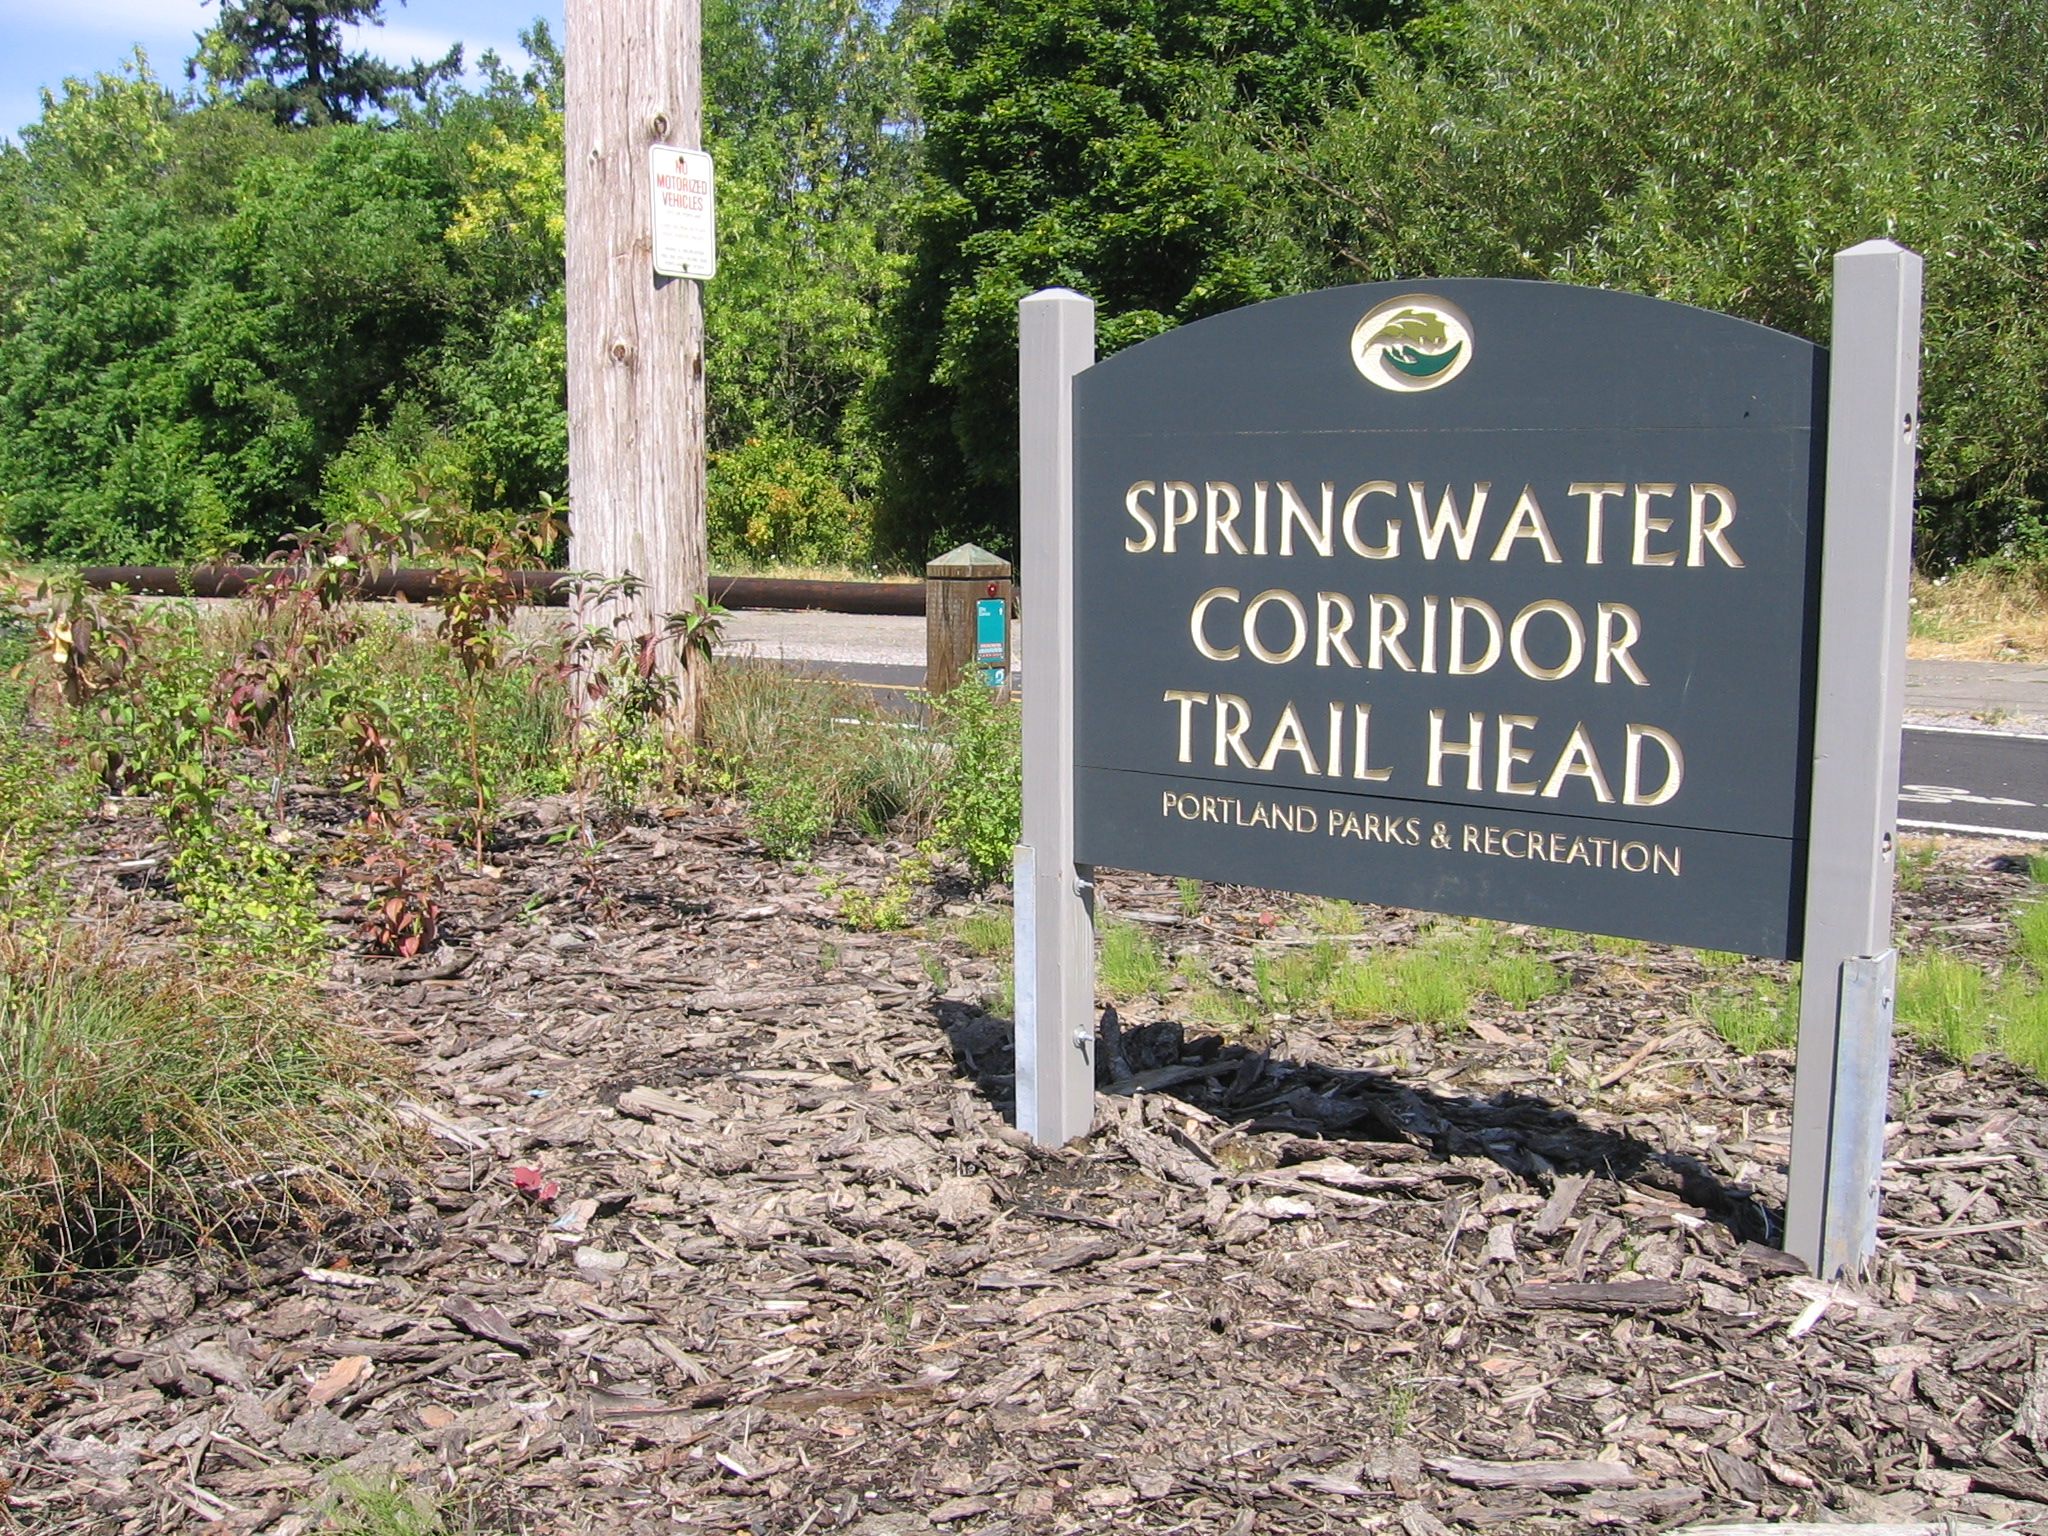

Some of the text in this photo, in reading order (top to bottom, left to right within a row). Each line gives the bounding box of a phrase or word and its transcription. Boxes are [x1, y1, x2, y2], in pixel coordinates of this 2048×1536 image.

[657, 173, 707, 195] MOTORIZED
[662, 191, 703, 211] VEHICLES
[675, 160, 688, 175] NO
[1125, 480, 1745, 568] SPRINGWATER
[1191, 587, 1650, 686] CORRIDOR
[1164, 690, 1685, 806] TRAIL HEAD
[1162, 792, 1683, 877] PORTLAND PARKS & RECREATION
